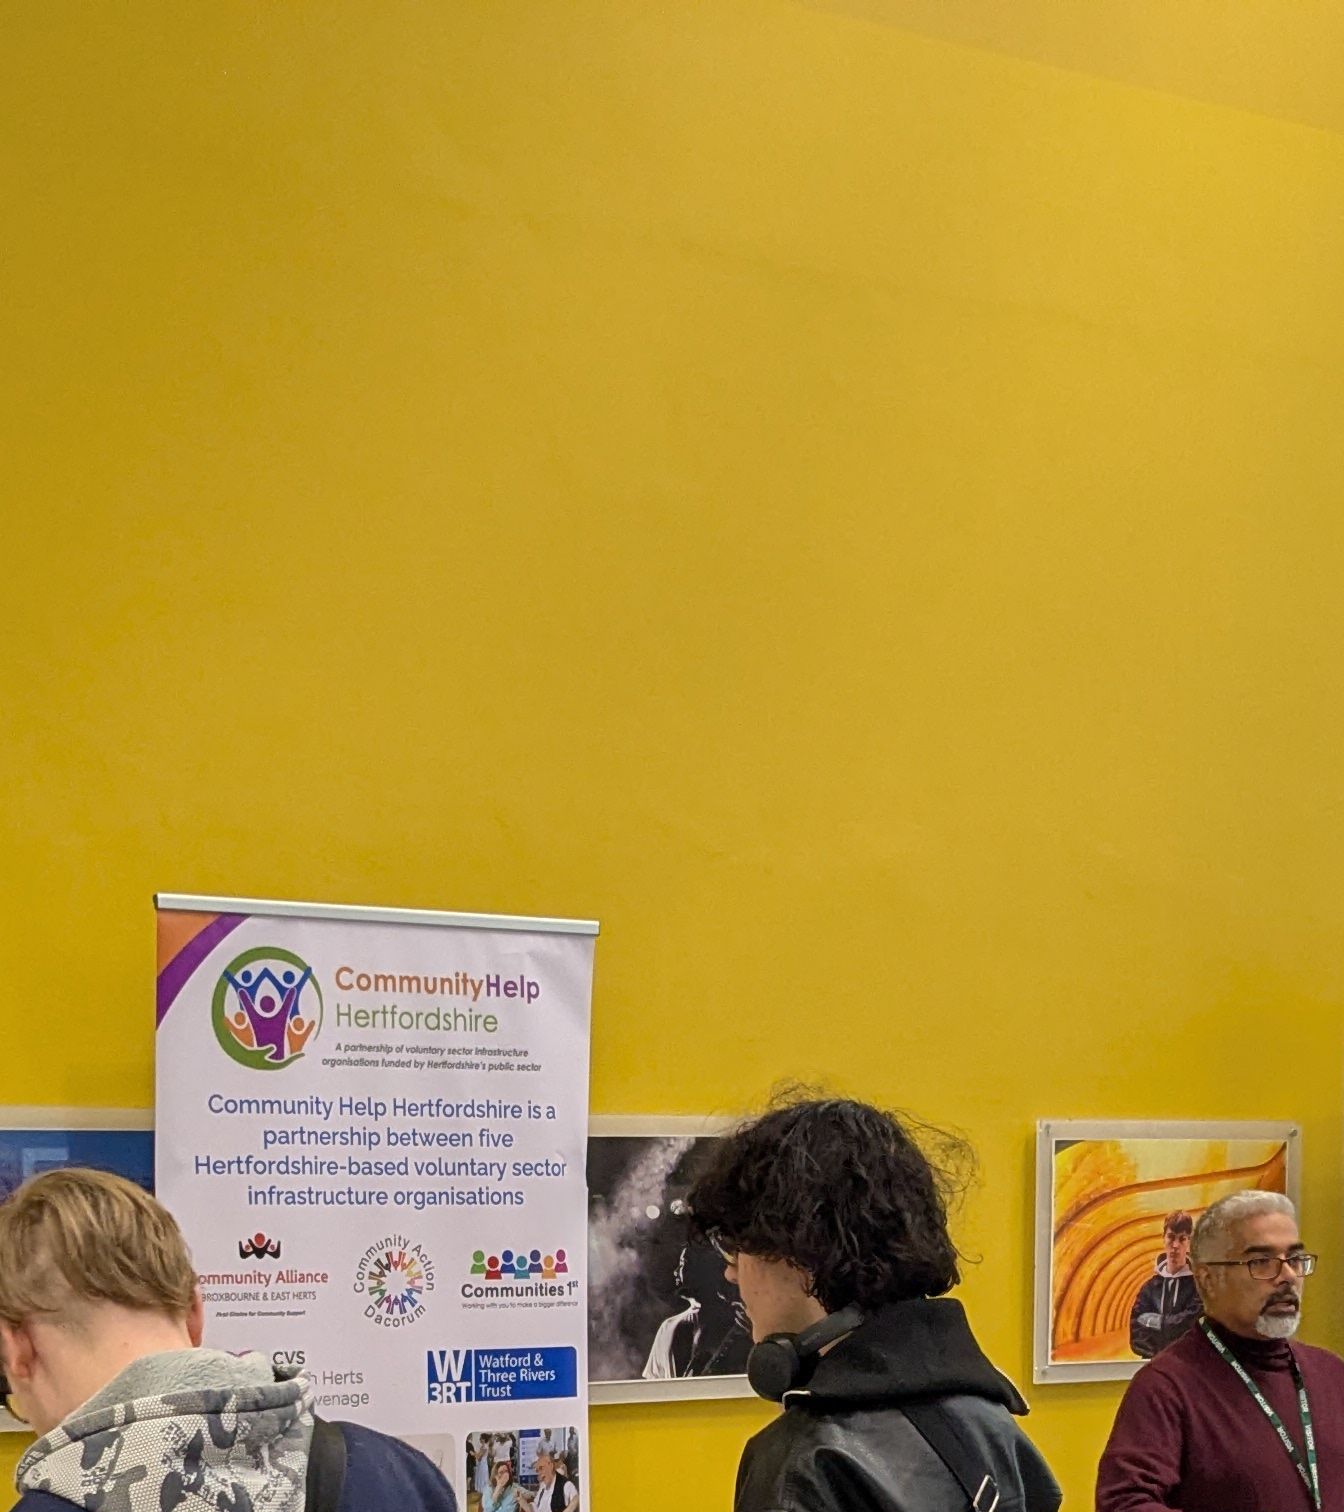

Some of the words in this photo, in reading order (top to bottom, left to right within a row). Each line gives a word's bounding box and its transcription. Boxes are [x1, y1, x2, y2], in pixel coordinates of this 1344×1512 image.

[335, 967, 540, 1004] CommunityHelp
[336, 1004, 498, 1032] Hertfordshire
[336, 1043, 342, 1051] A
[344, 1044, 393, 1053] partnership
[396, 1045, 403, 1053] of
[406, 1046, 445, 1056] voluntary
[447, 1047, 473, 1056] sector
[475, 1047, 528, 1057] infrastructure
[322, 1058, 379, 1069] organisations
[382, 1059, 412, 1068] funded
[414, 1060, 425, 1070] by
[427, 1061, 486, 1070] Hertfordshire's
[488, 1062, 514, 1072] public
[517, 1063, 541, 1072] sector
[208, 1095, 333, 1120] Community
[338, 1096, 387, 1122] Help
[392, 1099, 523, 1120] Hertfordshire
[527, 1101, 541, 1119] is
[544, 1106, 556, 1120] a
[263, 1129, 381, 1150] partnership
[386, 1128, 473, 1147] between
[479, 1129, 513, 1147] five
[195, 1156, 409, 1177] Hertfordshire-based
[414, 1158, 506, 1181] voluntary
[512, 1159, 566, 1178] sector
[248, 1186, 388, 1206] infrastructure
[394, 1189, 524, 1212] organisations
[354, 1234, 410, 1293] Community
[412, 1244, 434, 1290] Action
[198, 1271, 272, 1287] ommunity
[276, 1270, 328, 1284] Alliance
[262, 1292, 268, 1301] &
[271, 1292, 290, 1300] EAST
[292, 1291, 316, 1300] HERTS
[461, 1282, 564, 1298] Communities
[364, 1305, 426, 1327] Dacorum
[273, 1351, 305, 1364] CVS
[479, 1353, 529, 1368] Watford
[533, 1353, 543, 1367] &
[323, 1371, 363, 1385] Herts
[479, 1369, 515, 1383] Three
[520, 1368, 556, 1382] Rivers
[430, 1383, 470, 1402] 3RT
[479, 1383, 511, 1397] Trust
[314, 1392, 369, 1407] venage
[1277, 1427, 1294, 1453] VISITOR
